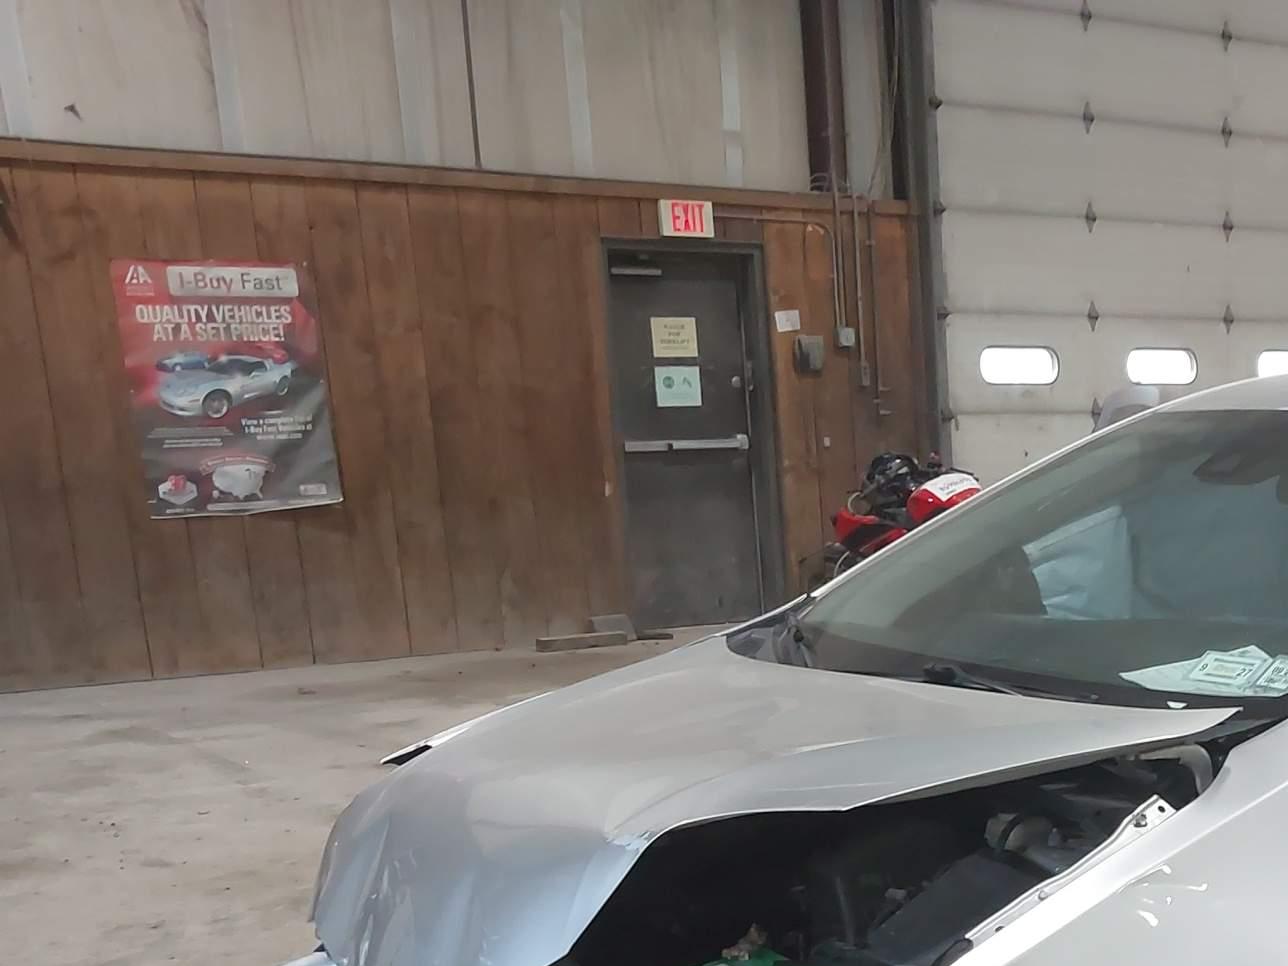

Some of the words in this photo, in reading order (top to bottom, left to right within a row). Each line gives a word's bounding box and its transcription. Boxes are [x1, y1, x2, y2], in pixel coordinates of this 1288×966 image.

[671, 202, 704, 233] EXIT
[178, 272, 233, 293] I-Buy
[241, 273, 283, 291] Fast
[135, 305, 209, 323] QUALITY
[212, 305, 292, 324] VEHICLES
[153, 323, 174, 342] AT
[180, 323, 193, 341] A
[197, 323, 227, 342] SET
[230, 323, 286, 342] PRICE!
